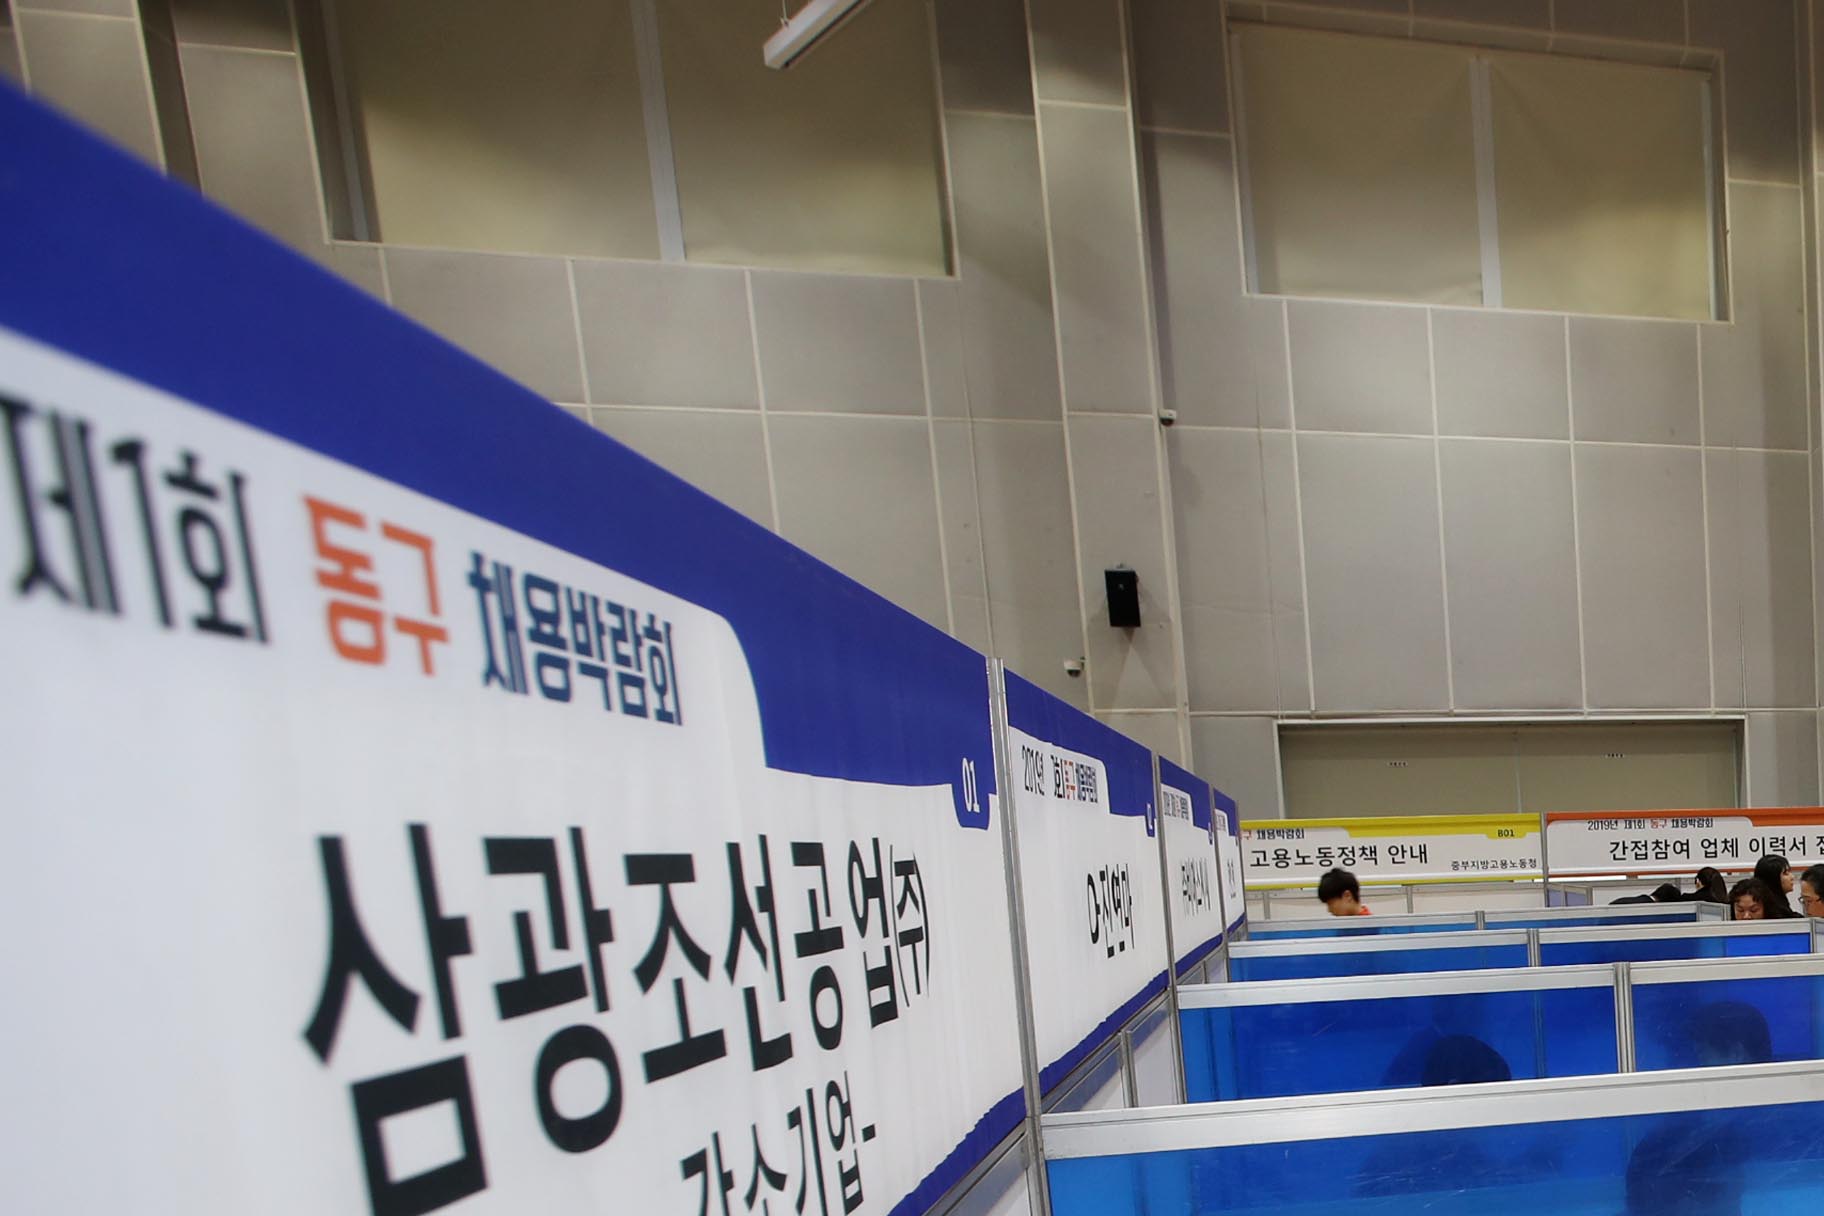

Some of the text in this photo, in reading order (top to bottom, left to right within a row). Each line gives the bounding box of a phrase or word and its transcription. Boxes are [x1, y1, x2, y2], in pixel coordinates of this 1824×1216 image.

[0, 393, 683, 727] 제1회 동구 채용박람회
[961, 757, 981, 814] 01
[1256, 828, 1305, 840] 채용박람회
[1497, 829, 1515, 838] B01
[1587, 817, 1714, 831] 2019년 제1회 동구 채용박람회
[1249, 842, 1428, 869] 고용노동정책 안내
[1609, 837, 1692, 862] 간접참여
[1700, 835, 1739, 860] 업체
[1749, 834, 1808, 858] 이력서
[1450, 858, 1537, 871] 중부지방고용노동청
